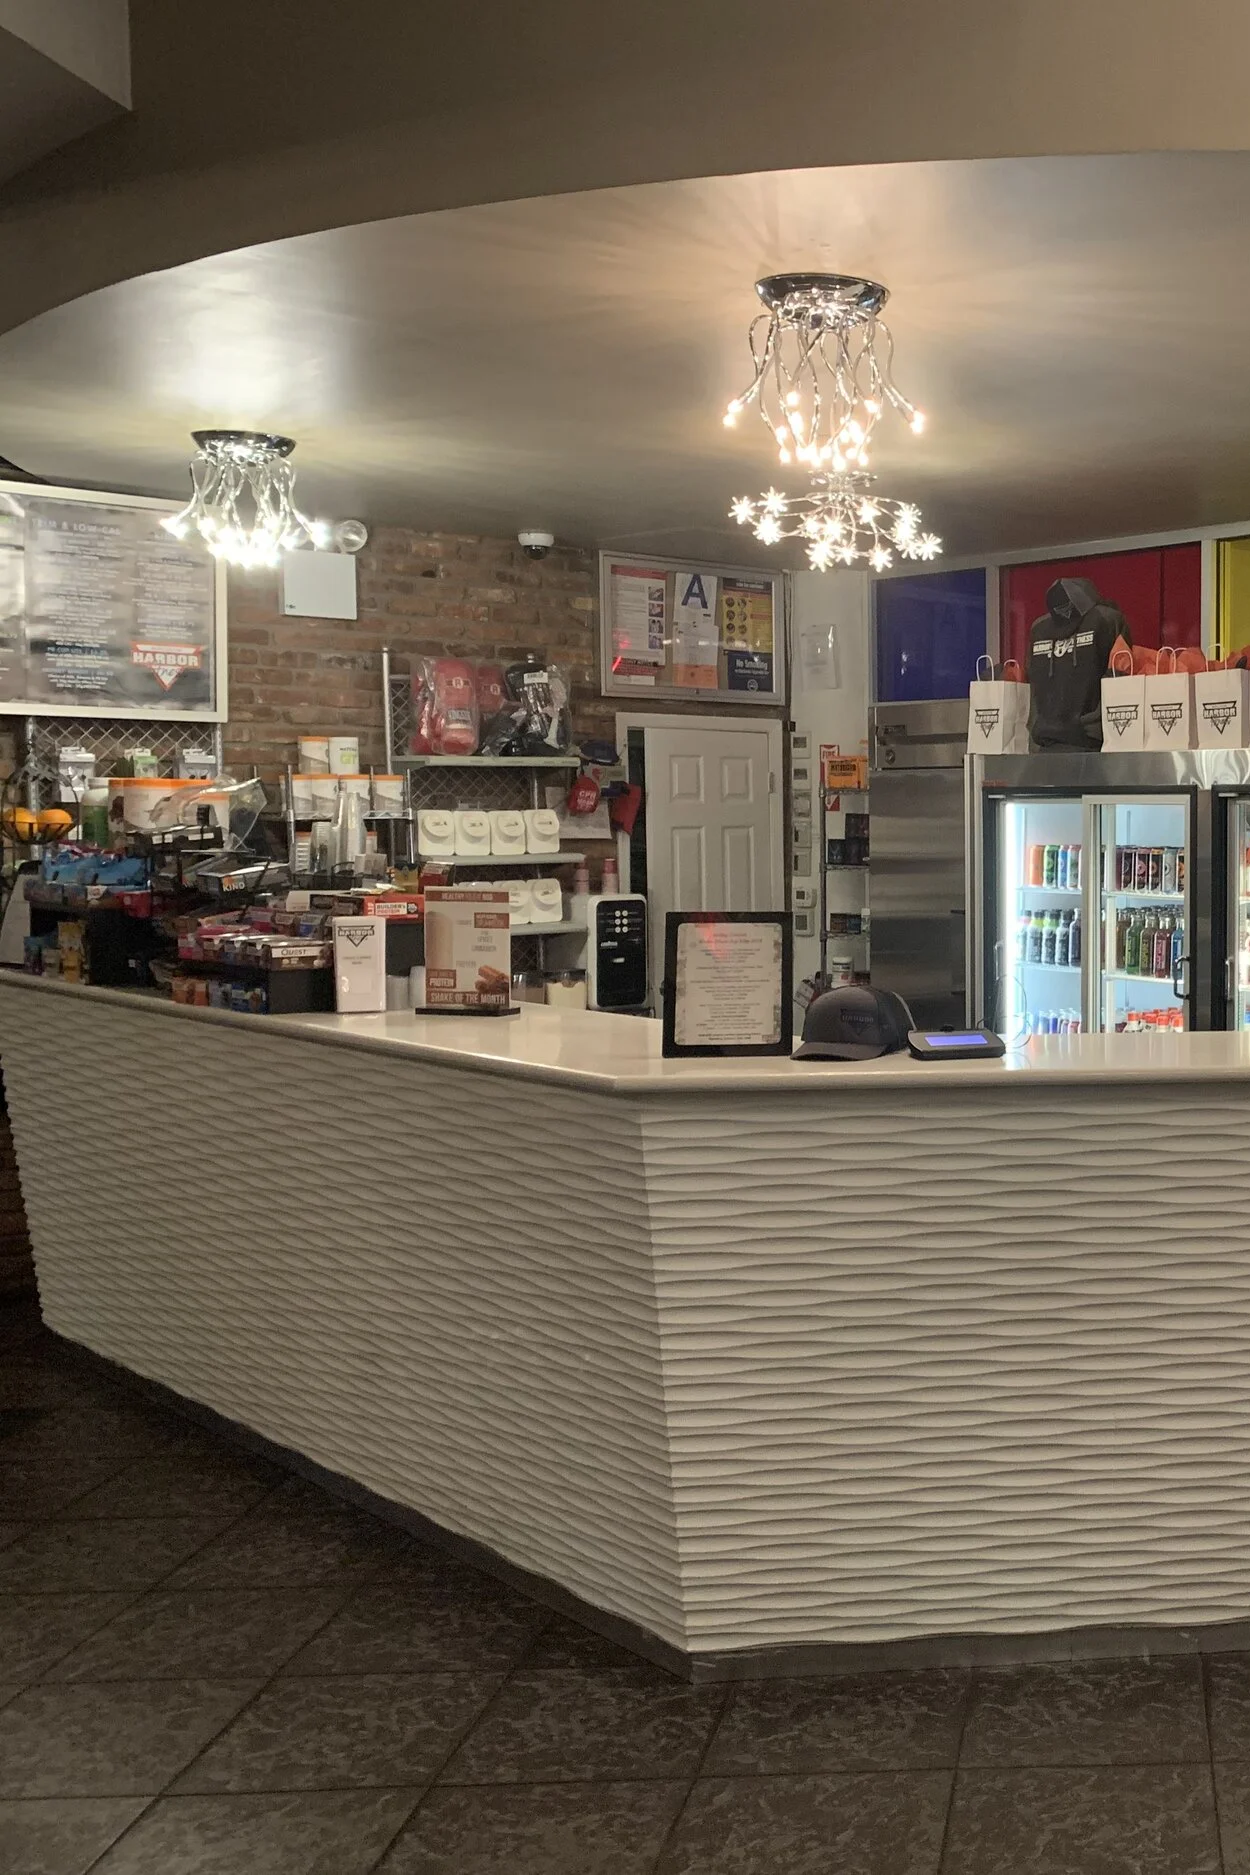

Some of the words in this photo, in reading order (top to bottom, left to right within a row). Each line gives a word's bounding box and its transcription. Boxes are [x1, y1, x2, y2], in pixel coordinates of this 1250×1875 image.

[681, 573, 709, 610] A
[132, 651, 199, 667] HARBOR
[1107, 710, 1138, 721] HARBOR
[1152, 709, 1182, 720] HARBOR
[1203, 708, 1236, 719] HARBOR
[222, 881, 245, 892] KIND
[281, 948, 306, 956] QUEST
[430, 993, 453, 1003] SHAKE
[455, 993, 465, 1003] OF
[466, 993, 479, 1004] THE
[481, 994, 506, 1005] MONTH
